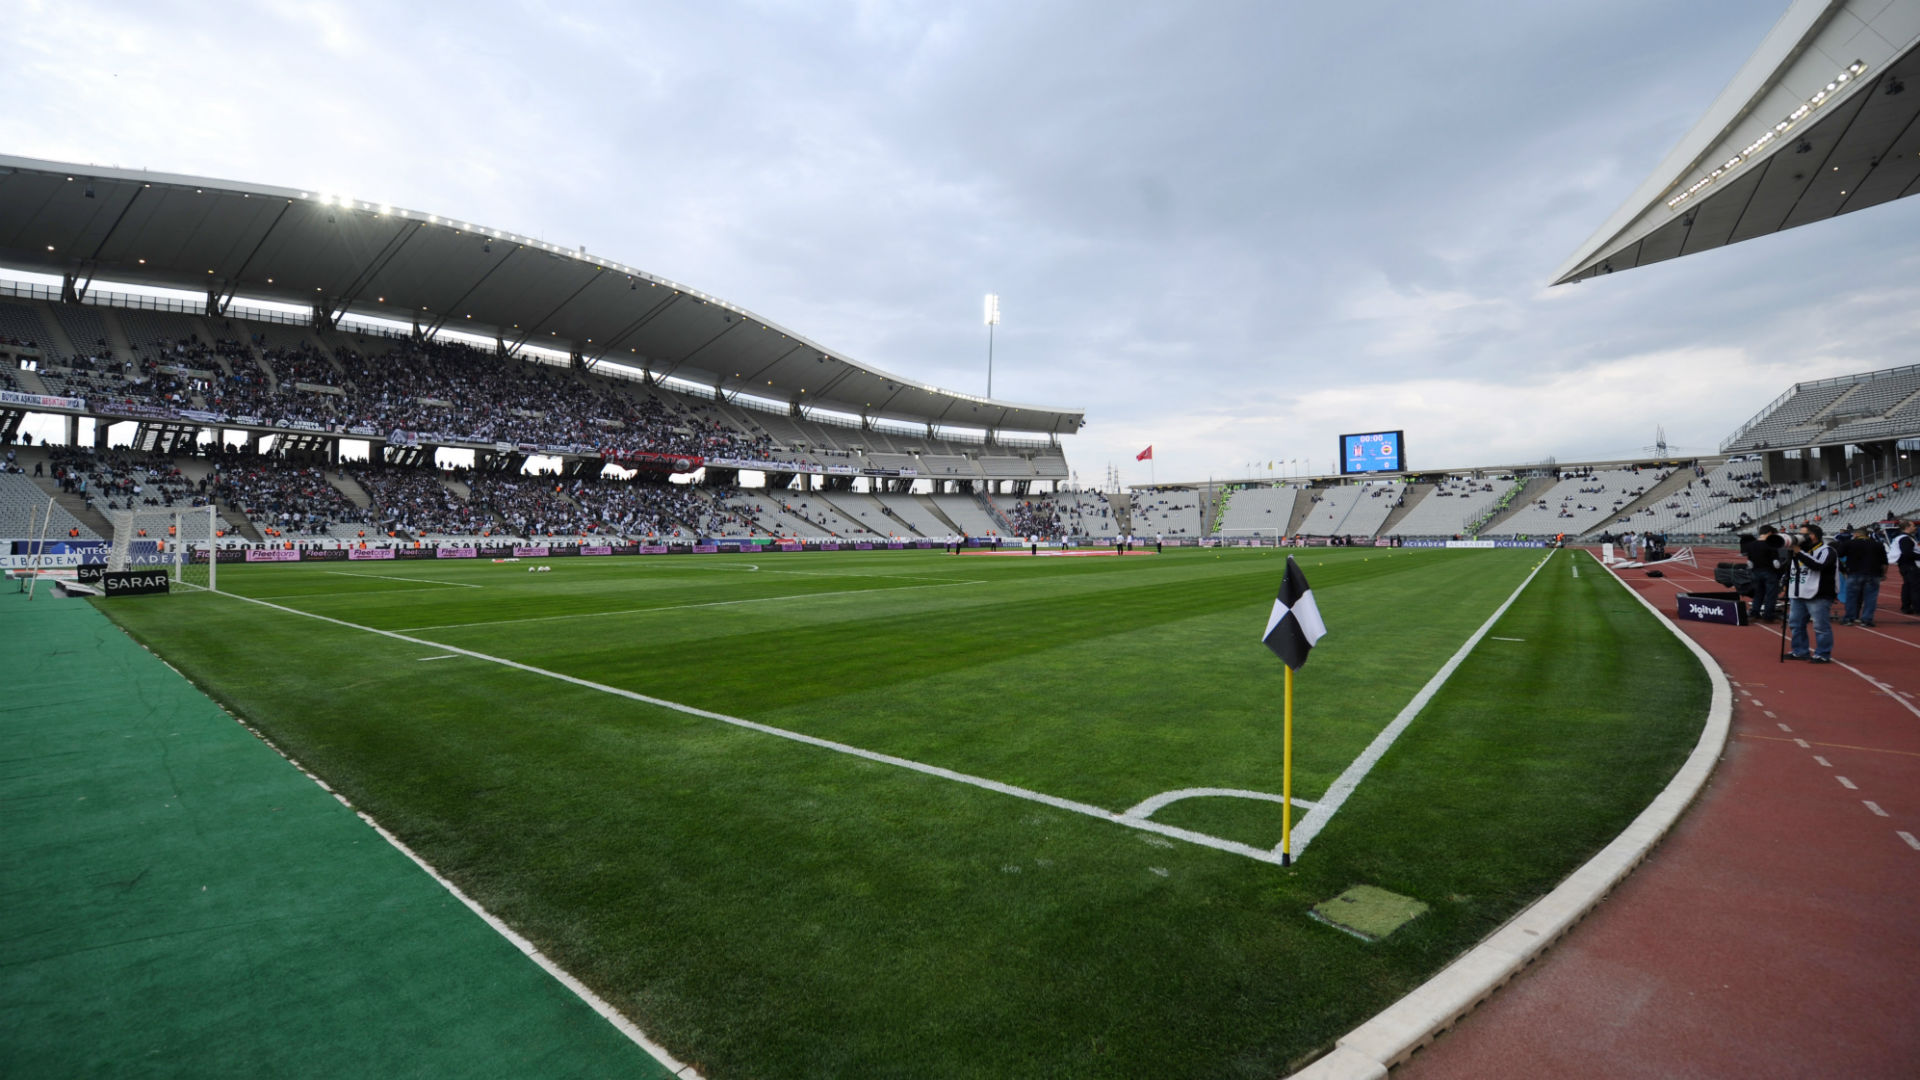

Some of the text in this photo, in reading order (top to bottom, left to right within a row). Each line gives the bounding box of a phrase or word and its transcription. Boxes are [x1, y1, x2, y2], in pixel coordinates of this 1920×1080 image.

[195, 550, 241, 558] Fletcorp
[306, 549, 344, 557] Fleetcorp
[107, 576, 166, 589] SARAR
